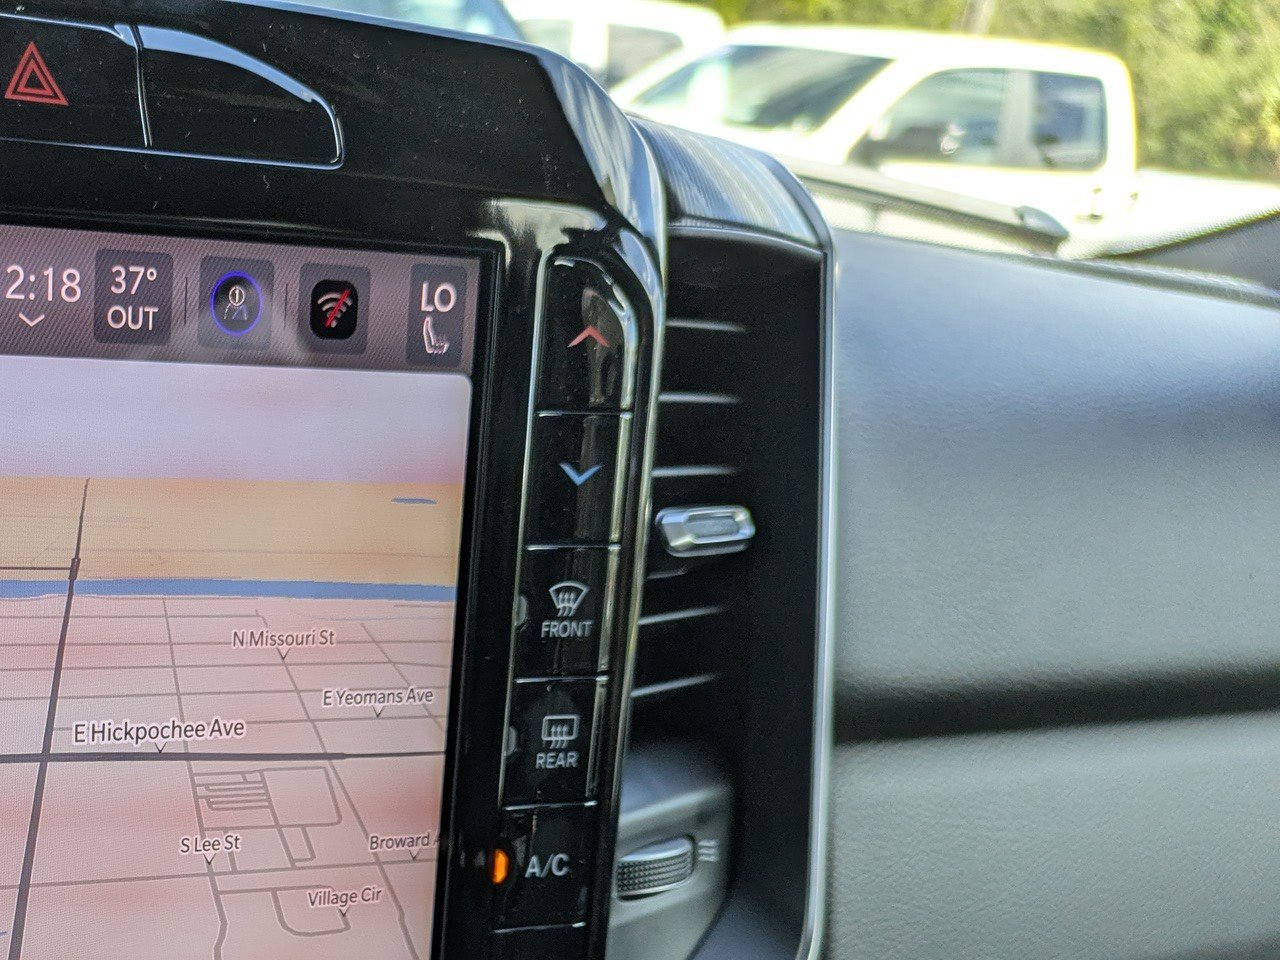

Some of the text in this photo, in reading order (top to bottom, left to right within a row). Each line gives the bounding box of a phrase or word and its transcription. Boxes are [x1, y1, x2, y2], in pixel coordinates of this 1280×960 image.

[420, 281, 456, 314] LO
[106, 306, 159, 331] OUT
[232, 629, 336, 647] N Missouri St
[540, 619, 593, 639] FRONT
[323, 687, 434, 707] E Yeomans Ave
[74, 718, 245, 744] E Hickpochee Ave
[536, 752, 579, 770] REAR
[180, 834, 241, 853] S Lee St
[369, 832, 430, 850] Broward
[525, 853, 570, 879] A/C
[308, 887, 382, 908] Village Cir
